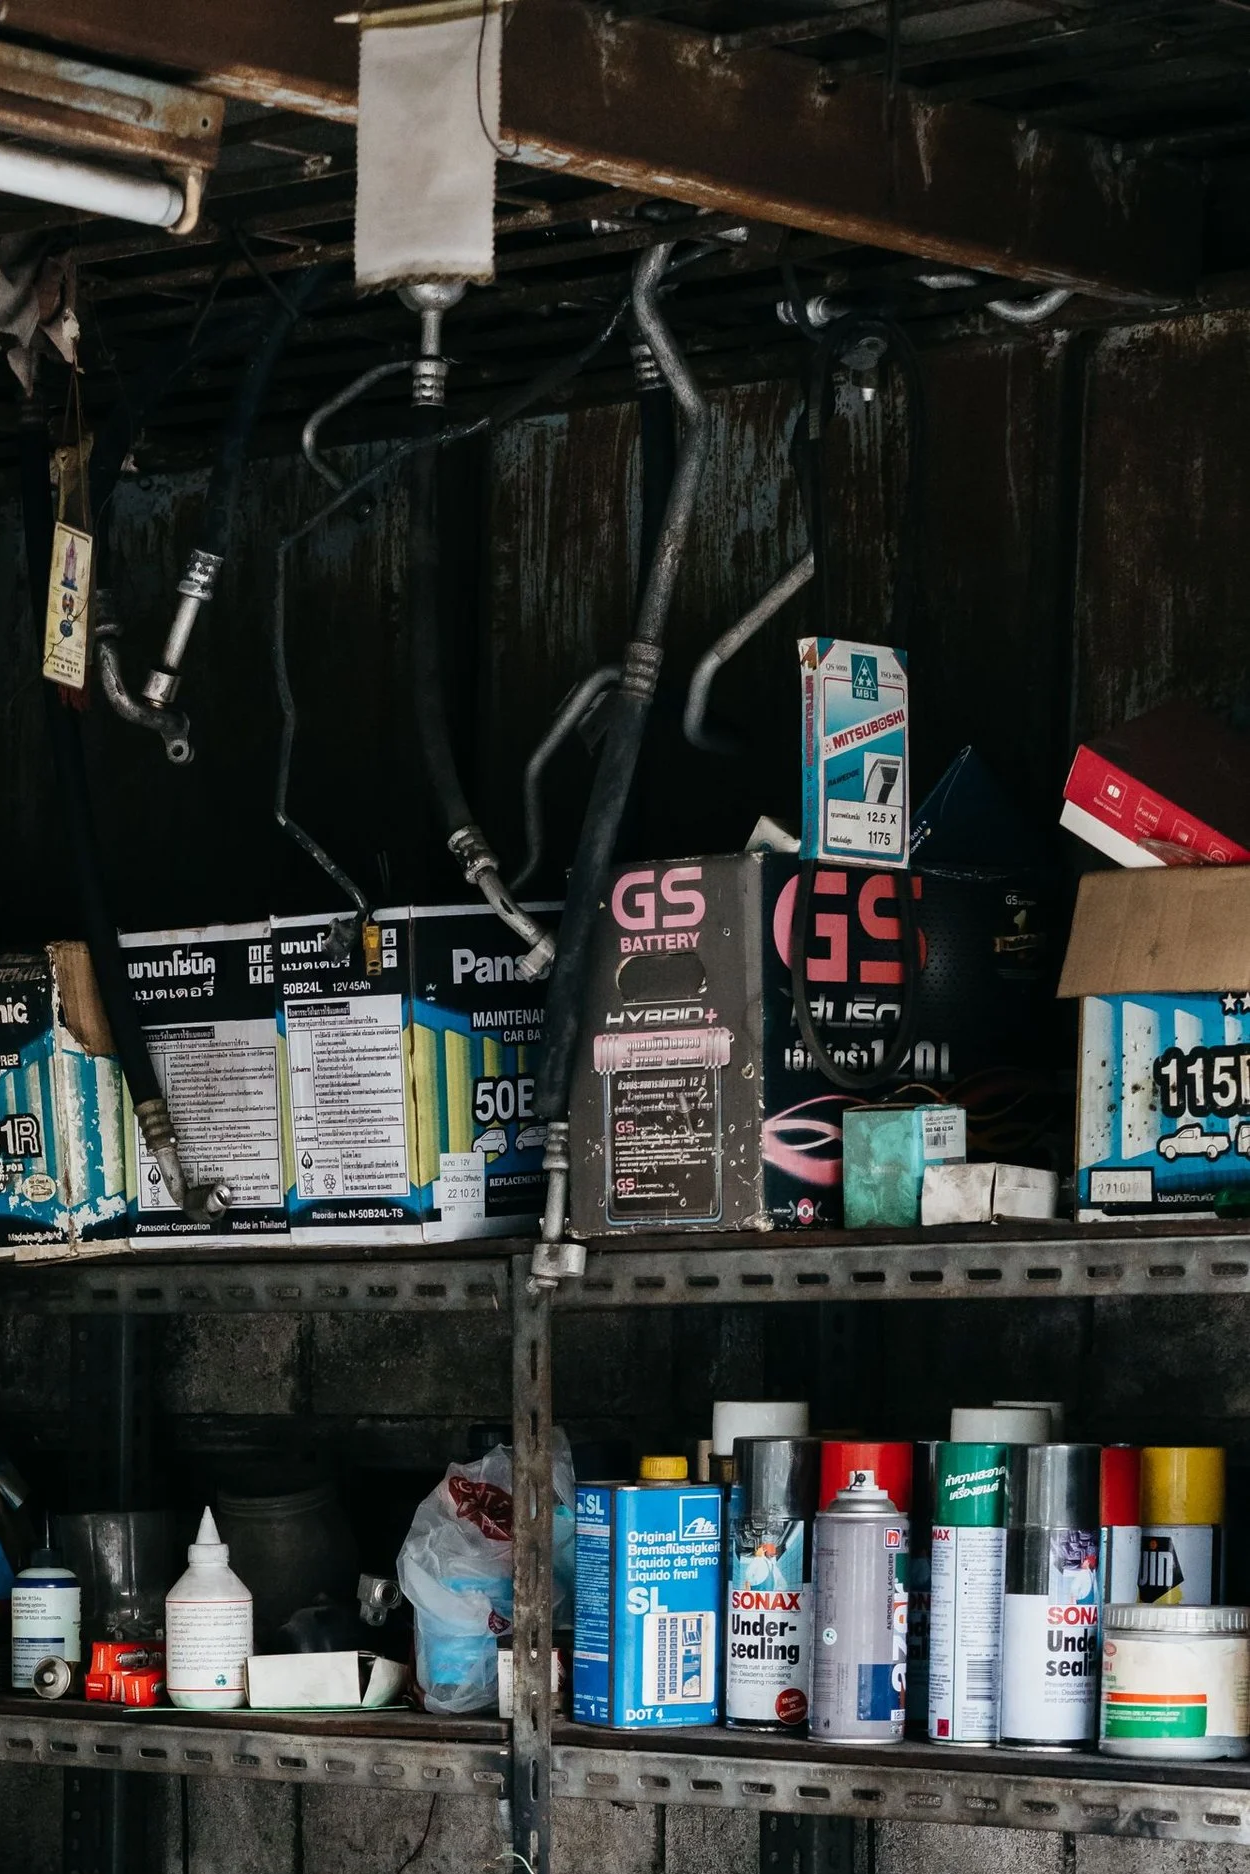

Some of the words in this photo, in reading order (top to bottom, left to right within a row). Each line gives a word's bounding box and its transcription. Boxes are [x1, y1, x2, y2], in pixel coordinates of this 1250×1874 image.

[855, 688, 875, 700] MBL
[831, 709, 905, 750] MITSUBOSHI
[866, 811, 886, 824] 12.5
[890, 813, 897, 825] X
[868, 830, 890, 846] 1175
[611, 866, 706, 931] GS
[773, 871, 928, 984] GS
[620, 932, 700, 954] BATTERY
[128, 950, 216, 979] พานาโซนิค
[283, 983, 322, 995] 50B24L
[332, 981, 347, 992] 12V
[348, 980, 371, 991] 45Ah
[503, 1030, 525, 1042] CAR
[616, 1121, 635, 1133] GS
[489, 1175, 538, 1187] REPLACEMENT
[616, 1178, 635, 1191] GS
[448, 1189, 457, 1199] 22
[460, 1188, 469, 1198] 10
[471, 1187, 480, 1198] 21
[349, 1208, 404, 1219] N-50B24L-TS
[136, 1223, 170, 1232] Panasonic
[171, 1223, 210, 1232] Corporation
[259, 1220, 287, 1229] Thailand
[945, 1465, 1006, 1488] ทำความสะอาด
[586, 1493, 604, 1516] SL
[628, 1531, 676, 1544] Original
[628, 1542, 720, 1556] Bremsflüssigkeit
[628, 1557, 671, 1570] Líquido
[674, 1557, 688, 1568] de
[690, 1556, 718, 1567] freno
[628, 1570, 670, 1583] Liquido
[673, 1568, 698, 1580] freni
[626, 1586, 668, 1614] SL
[732, 1591, 801, 1611] SONAX
[732, 1614, 797, 1635] Under-
[731, 1638, 801, 1665] sealing
[625, 1708, 653, 1722] DOT
[655, 1707, 664, 1720] 4
